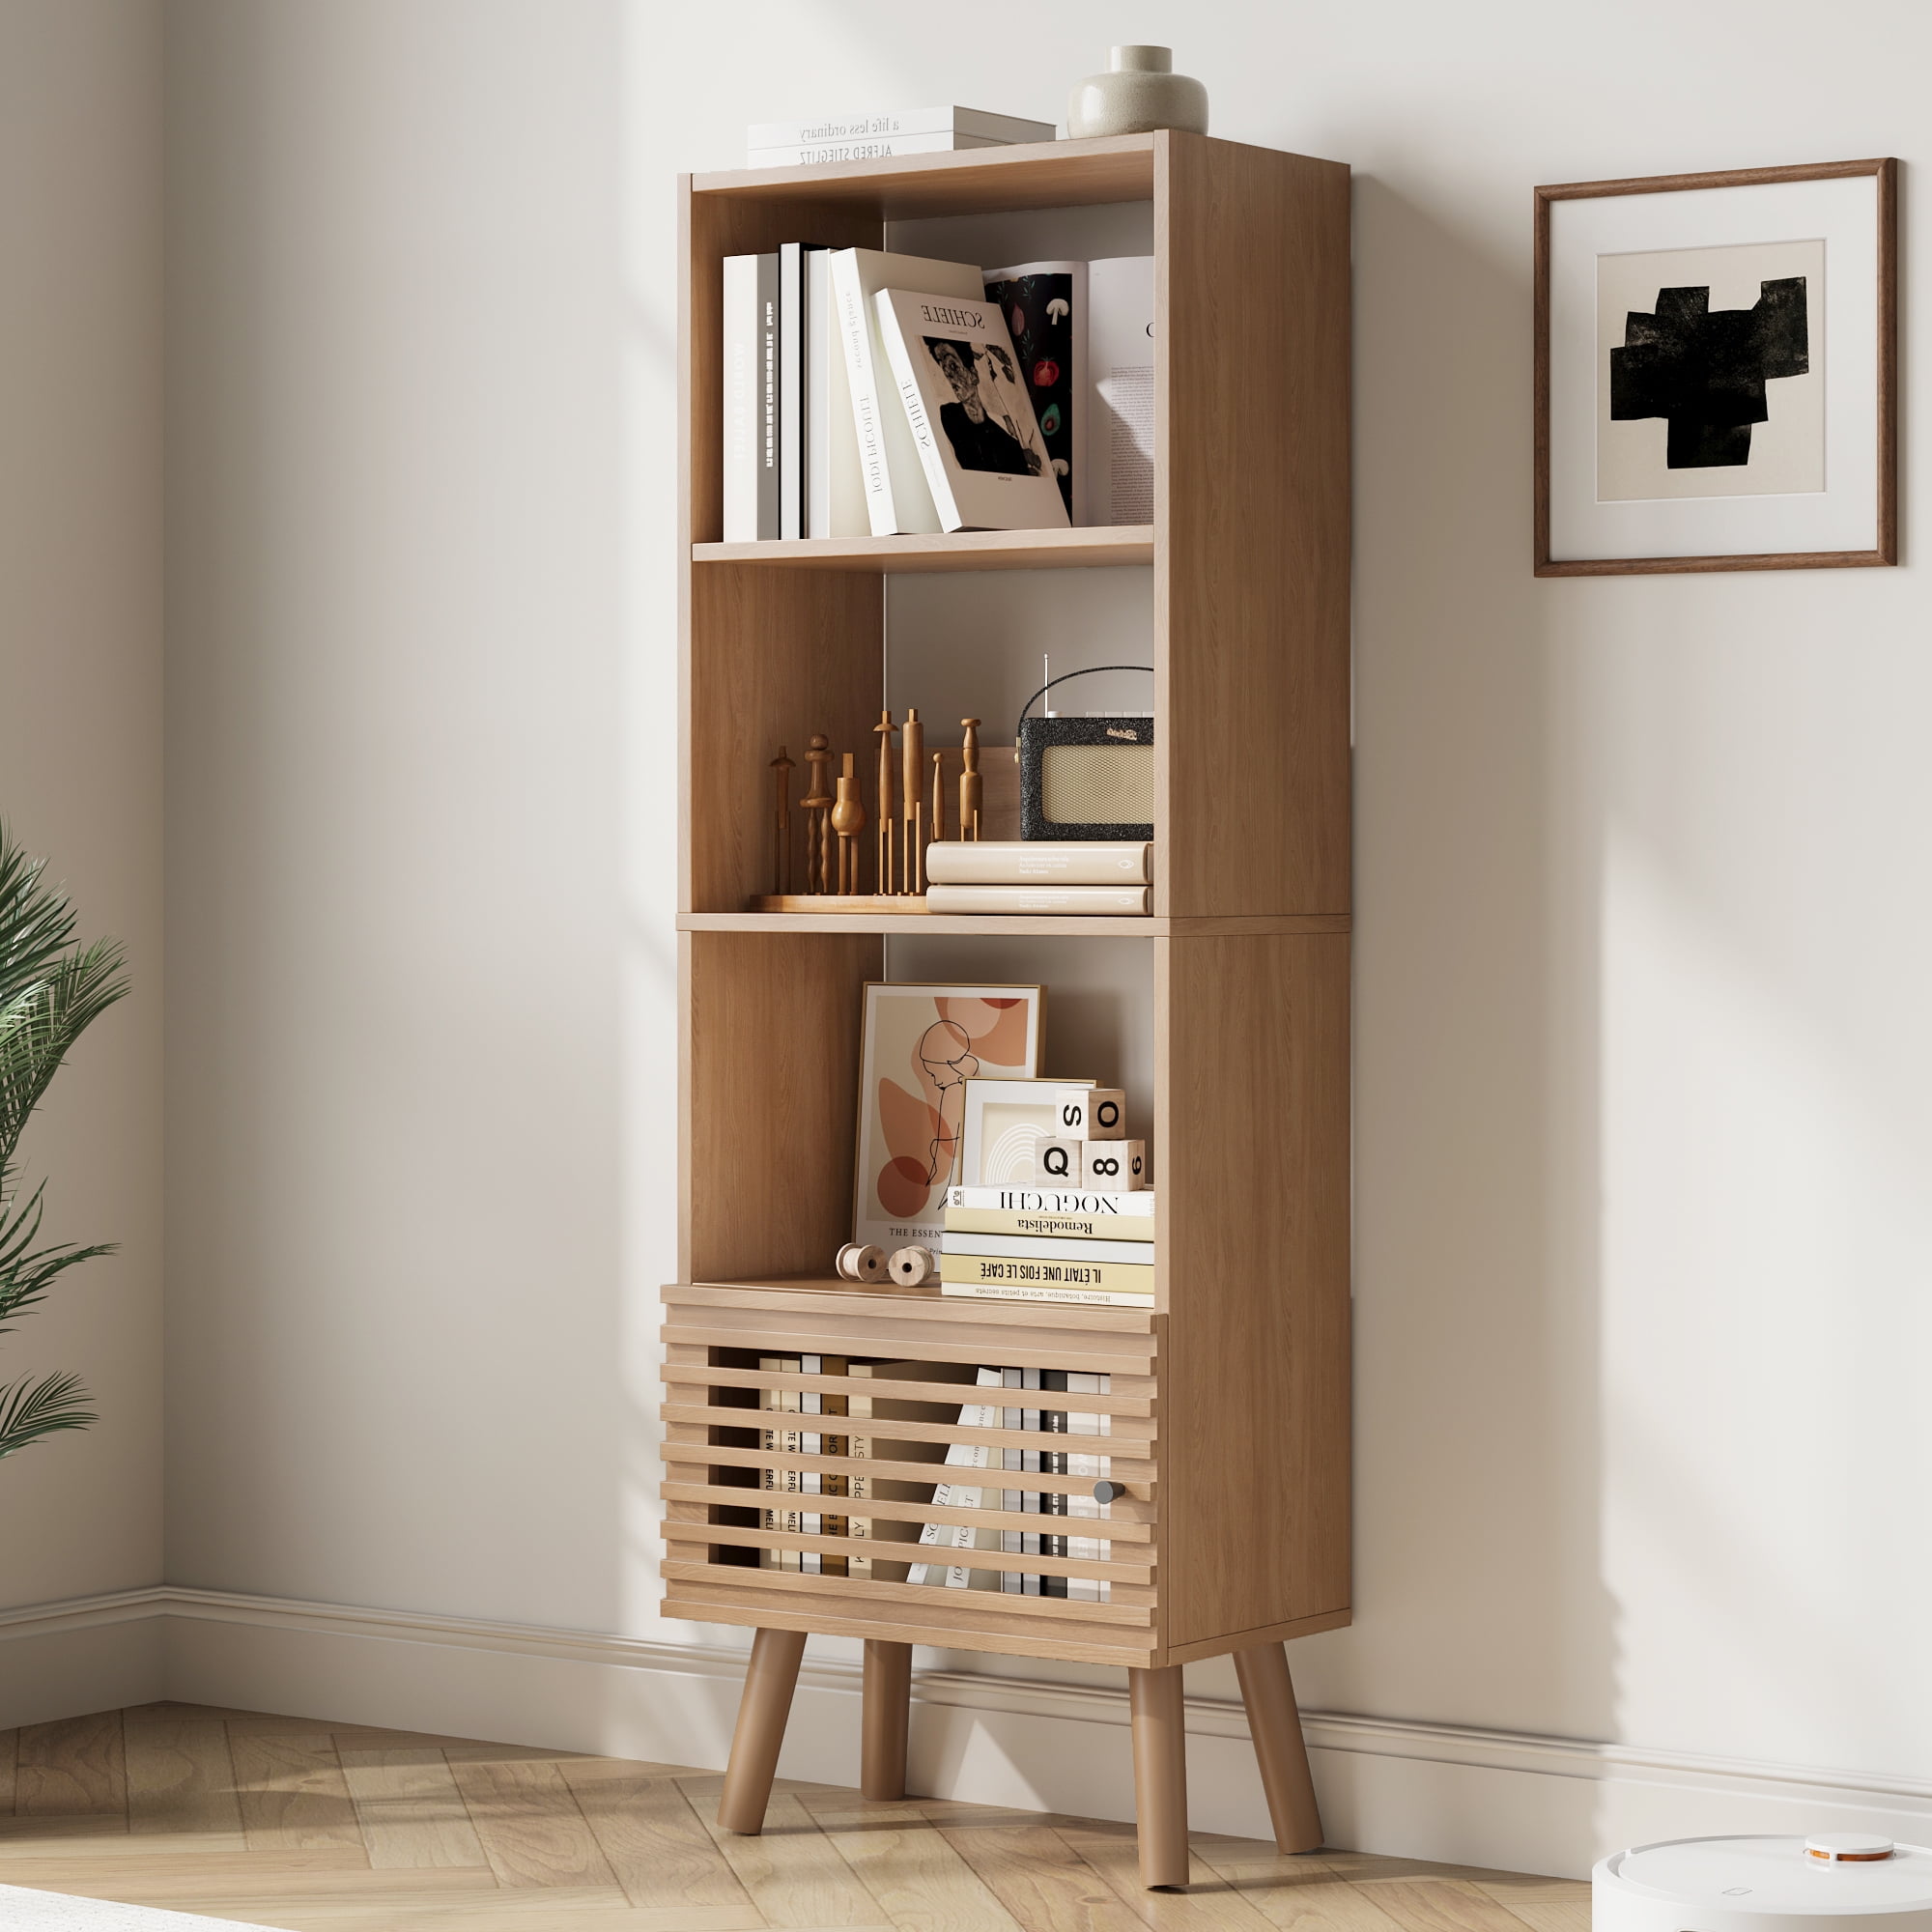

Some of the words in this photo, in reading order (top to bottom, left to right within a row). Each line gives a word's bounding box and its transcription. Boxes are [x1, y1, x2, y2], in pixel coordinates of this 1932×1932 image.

[1063, 1104, 1082, 1126] S
[1043, 1147, 1069, 1178] Q
[1093, 1158, 1120, 1177] 8
[999, 1191, 1119, 1214] NOGUCHI
[889, 1228, 909, 1236] THE
[912, 1229, 943, 1238] ESSEN
[1017, 1219, 1094, 1236] Remodelista
[980, 1263, 1004, 1280] CAFÉ
[1006, 1264, 1017, 1279] LE
[1019, 1264, 1040, 1280] FOIS
[1042, 1266, 1062, 1282] UNE
[1064, 1267, 1090, 1286] ÉTAIT
[1093, 1268, 1101, 1284] IL
[1045, 1291, 1080, 1301] botanique,
[1083, 1293, 1111, 1303] Histoire,
